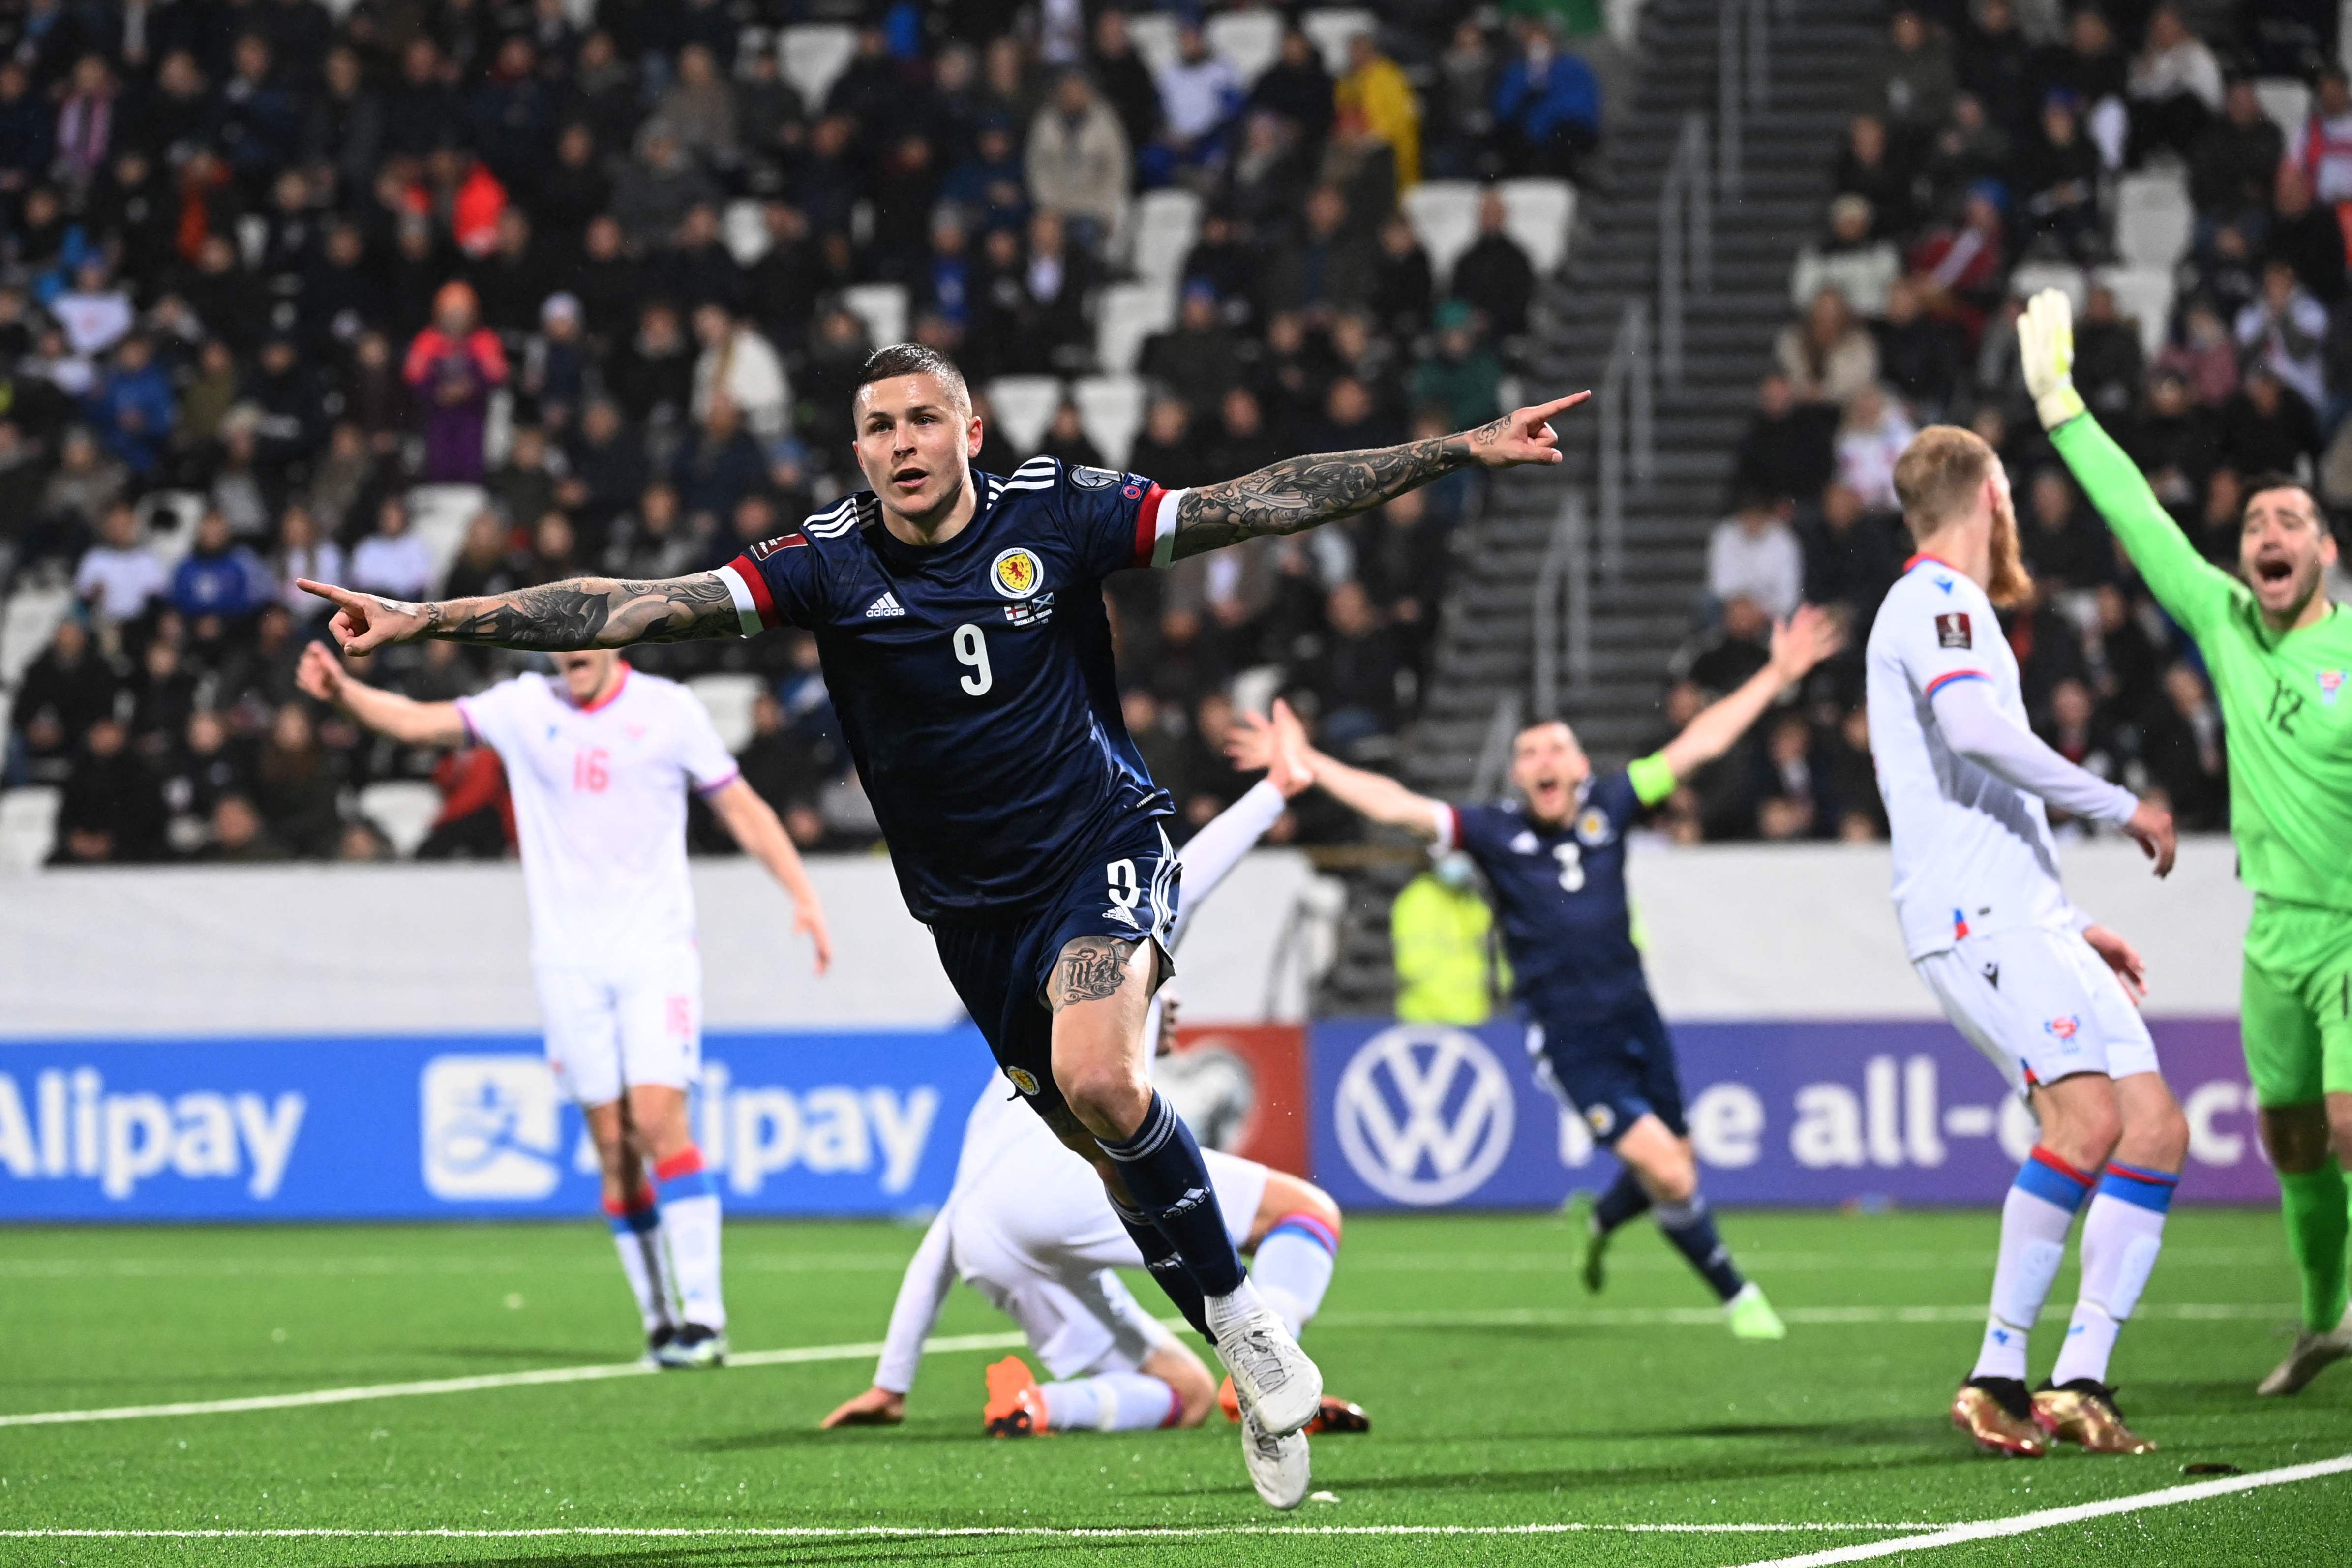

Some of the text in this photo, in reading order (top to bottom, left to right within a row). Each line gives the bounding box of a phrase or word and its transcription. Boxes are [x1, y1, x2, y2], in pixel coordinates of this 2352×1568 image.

[866, 608, 905, 617] adidas
[953, 623, 992, 696] 9
[2266, 679, 2305, 737] 12
[573, 748, 610, 793] 16
[574, 1061, 940, 1196] ipay
